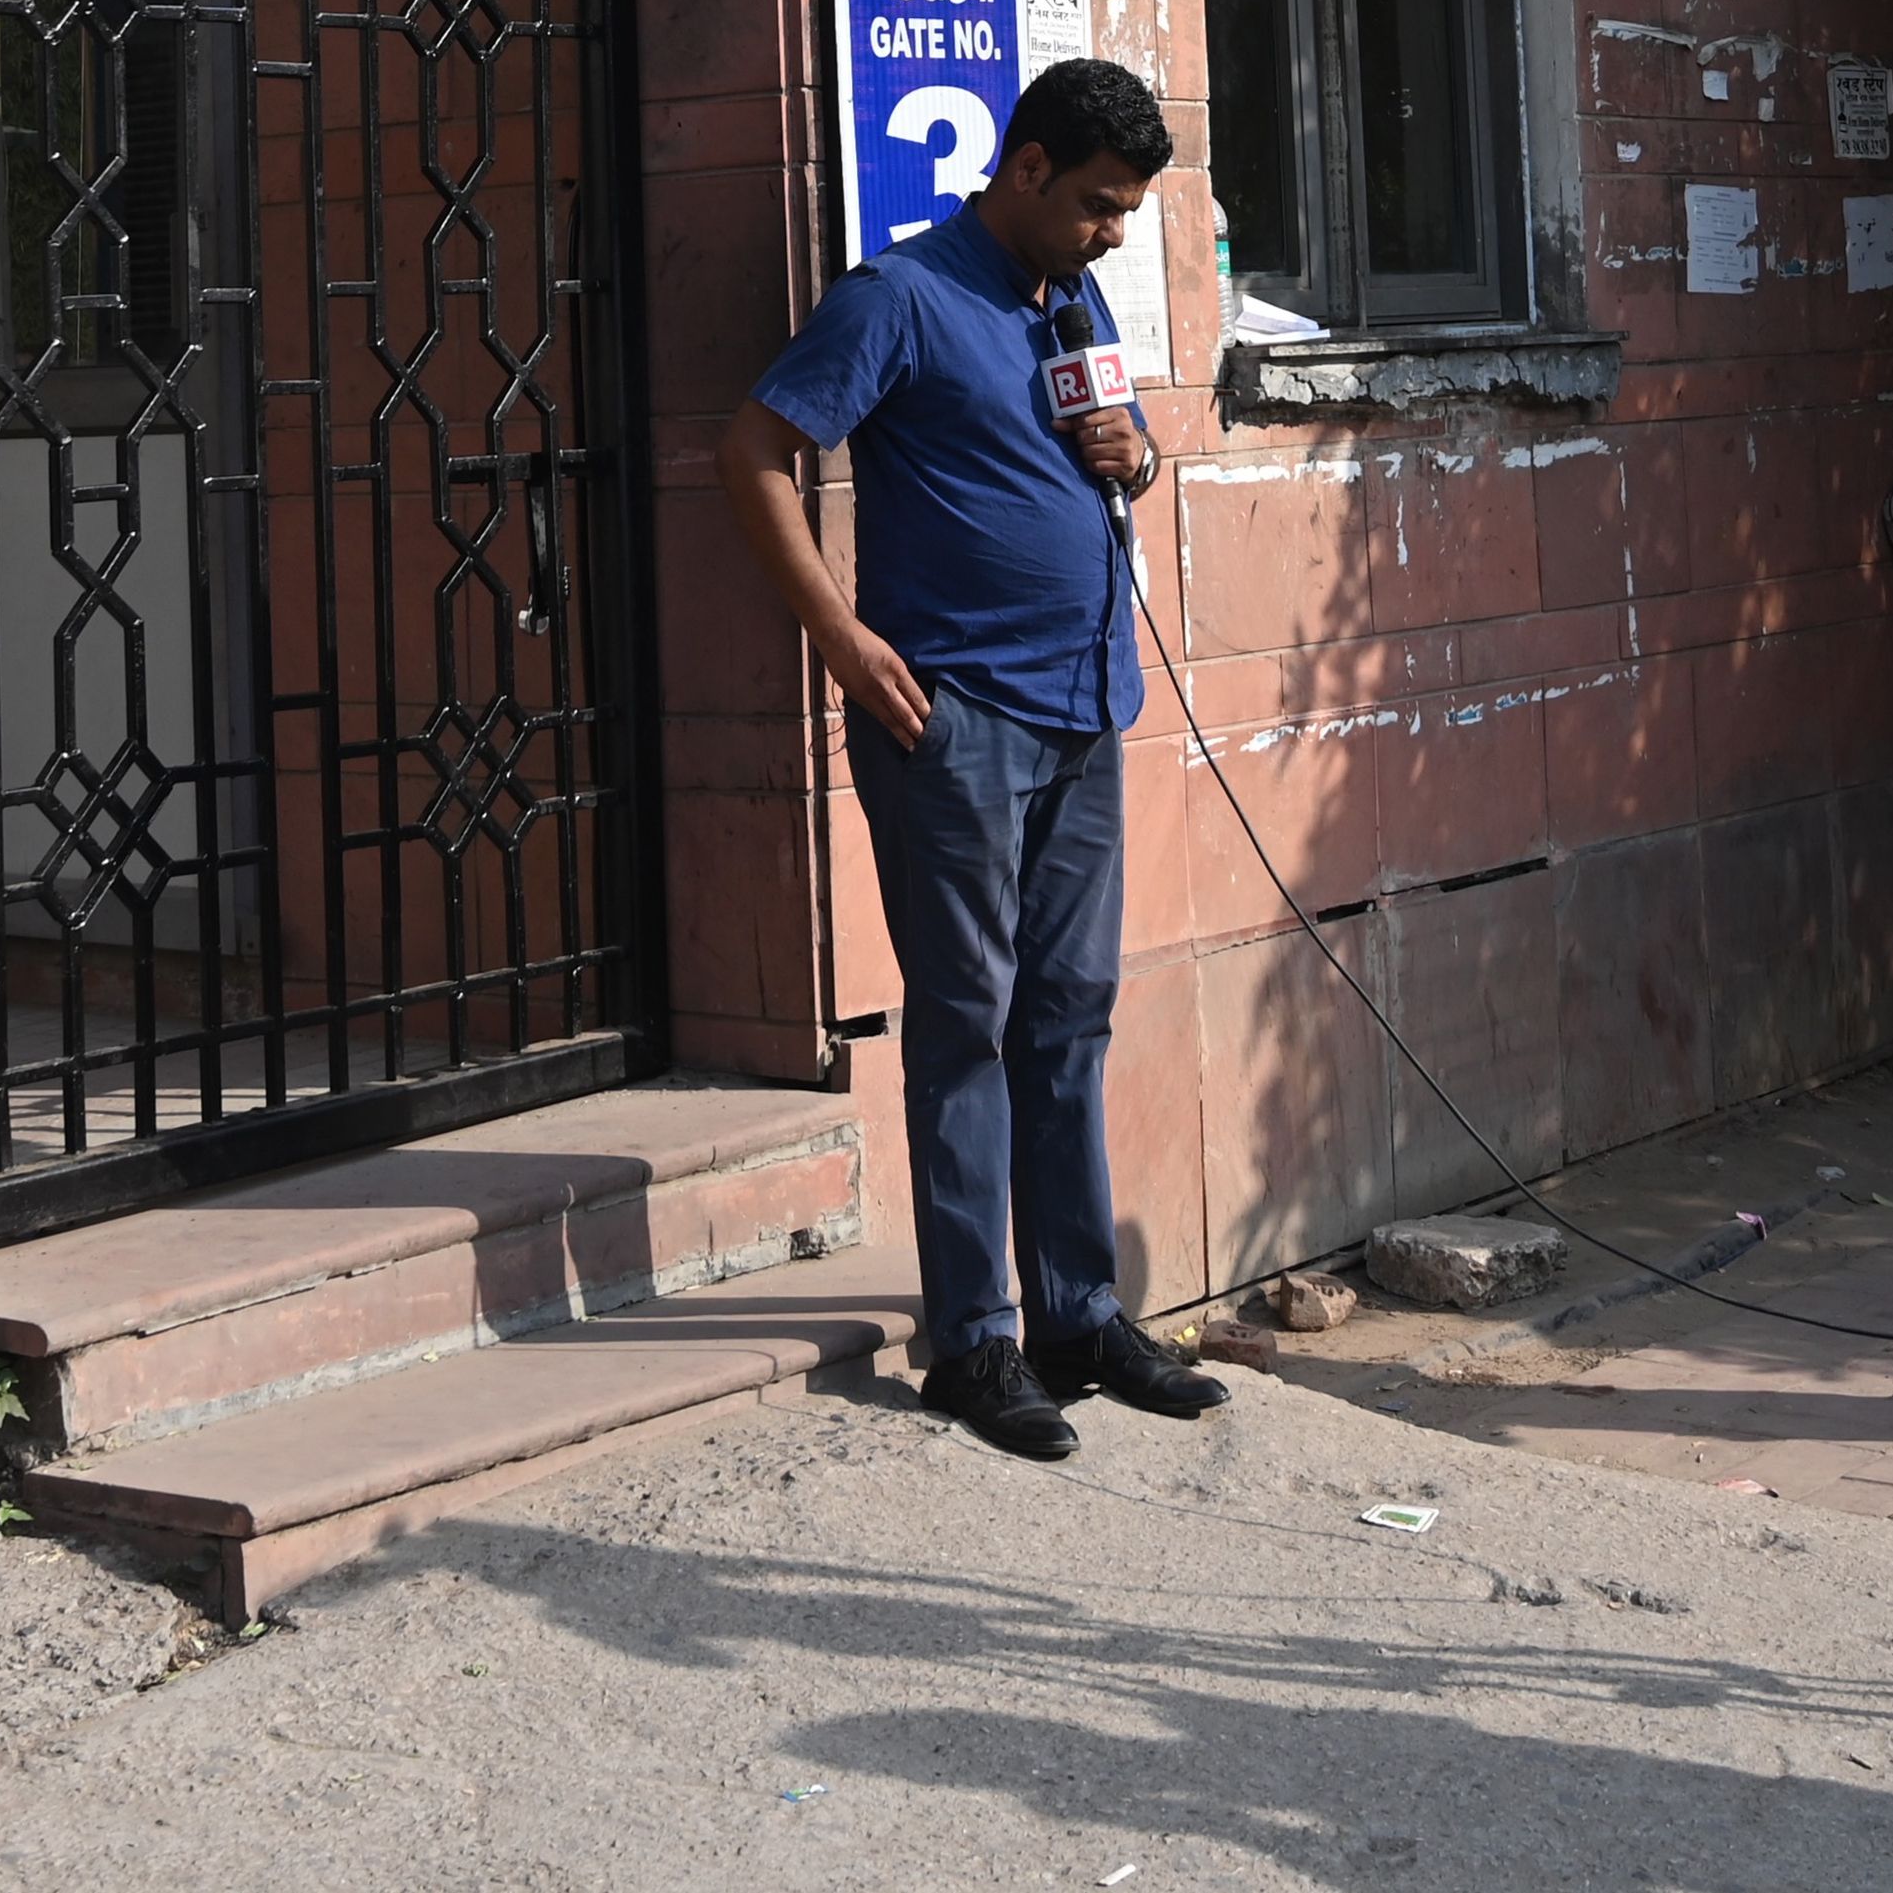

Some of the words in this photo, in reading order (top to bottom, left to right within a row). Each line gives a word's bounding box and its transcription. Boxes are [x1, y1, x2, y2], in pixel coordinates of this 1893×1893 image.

[870, 17, 946, 60] GATE
[953, 20, 1002, 62] NO.
[886, 86, 997, 244] 3
[1055, 370, 1088, 401] R.
[1099, 359, 1125, 391] R.
